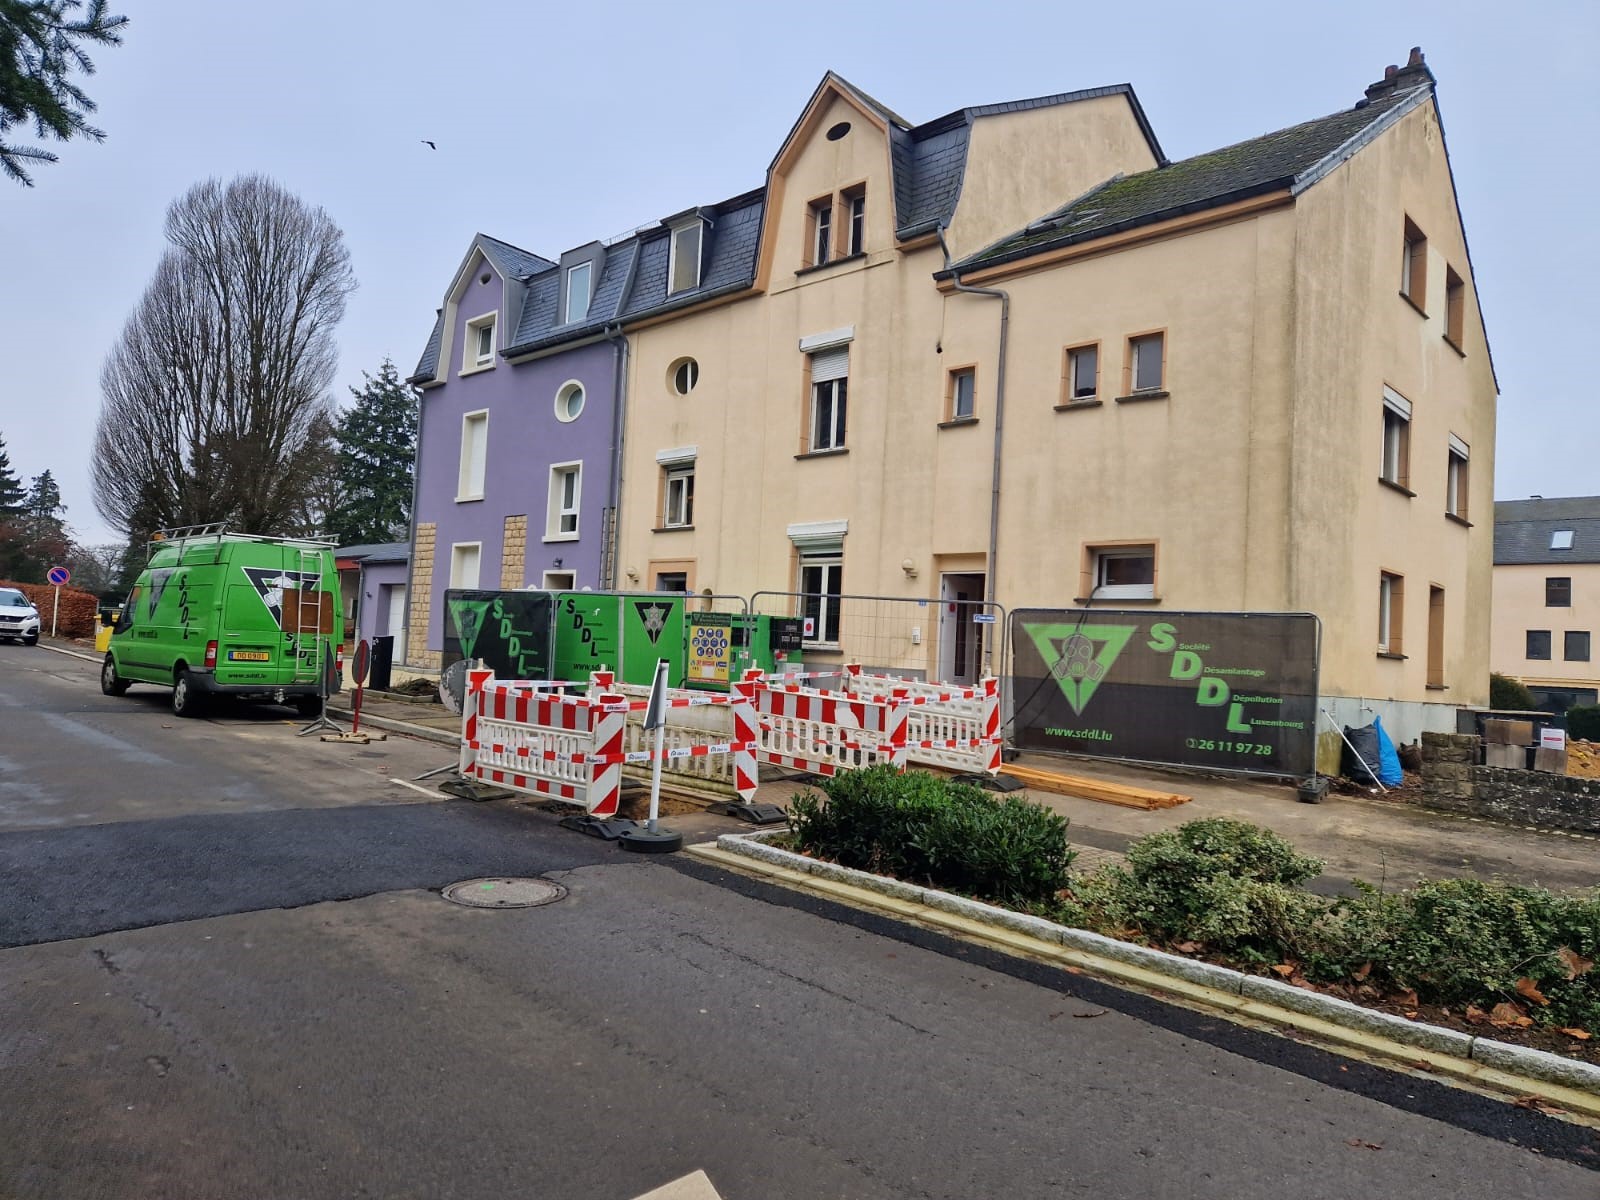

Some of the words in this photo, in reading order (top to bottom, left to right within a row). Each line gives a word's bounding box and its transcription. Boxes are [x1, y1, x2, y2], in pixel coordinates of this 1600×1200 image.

[566, 599, 575, 614] S
[573, 614, 583, 629] D
[581, 628, 591, 643] D
[1147, 622, 1178, 653] S
[1179, 642, 1211, 651] Société
[590, 642, 598, 657] L
[573, 663, 614, 672] www.sd.lu
[1170, 650, 1203, 680] D
[1203, 666, 1266, 677] Désamiantage
[1196, 677, 1231, 707] D
[1232, 694, 1284, 704] Dépollution
[1226, 703, 1252, 734] L
[1251, 718, 1304, 730] Luxembourg
[1044, 727, 1113, 741] www.sddl.lu
[1198, 739, 1215, 751] 26
[1218, 741, 1232, 751] 11
[1236, 742, 1253, 754] 97
[1254, 744, 1273, 756] 28
